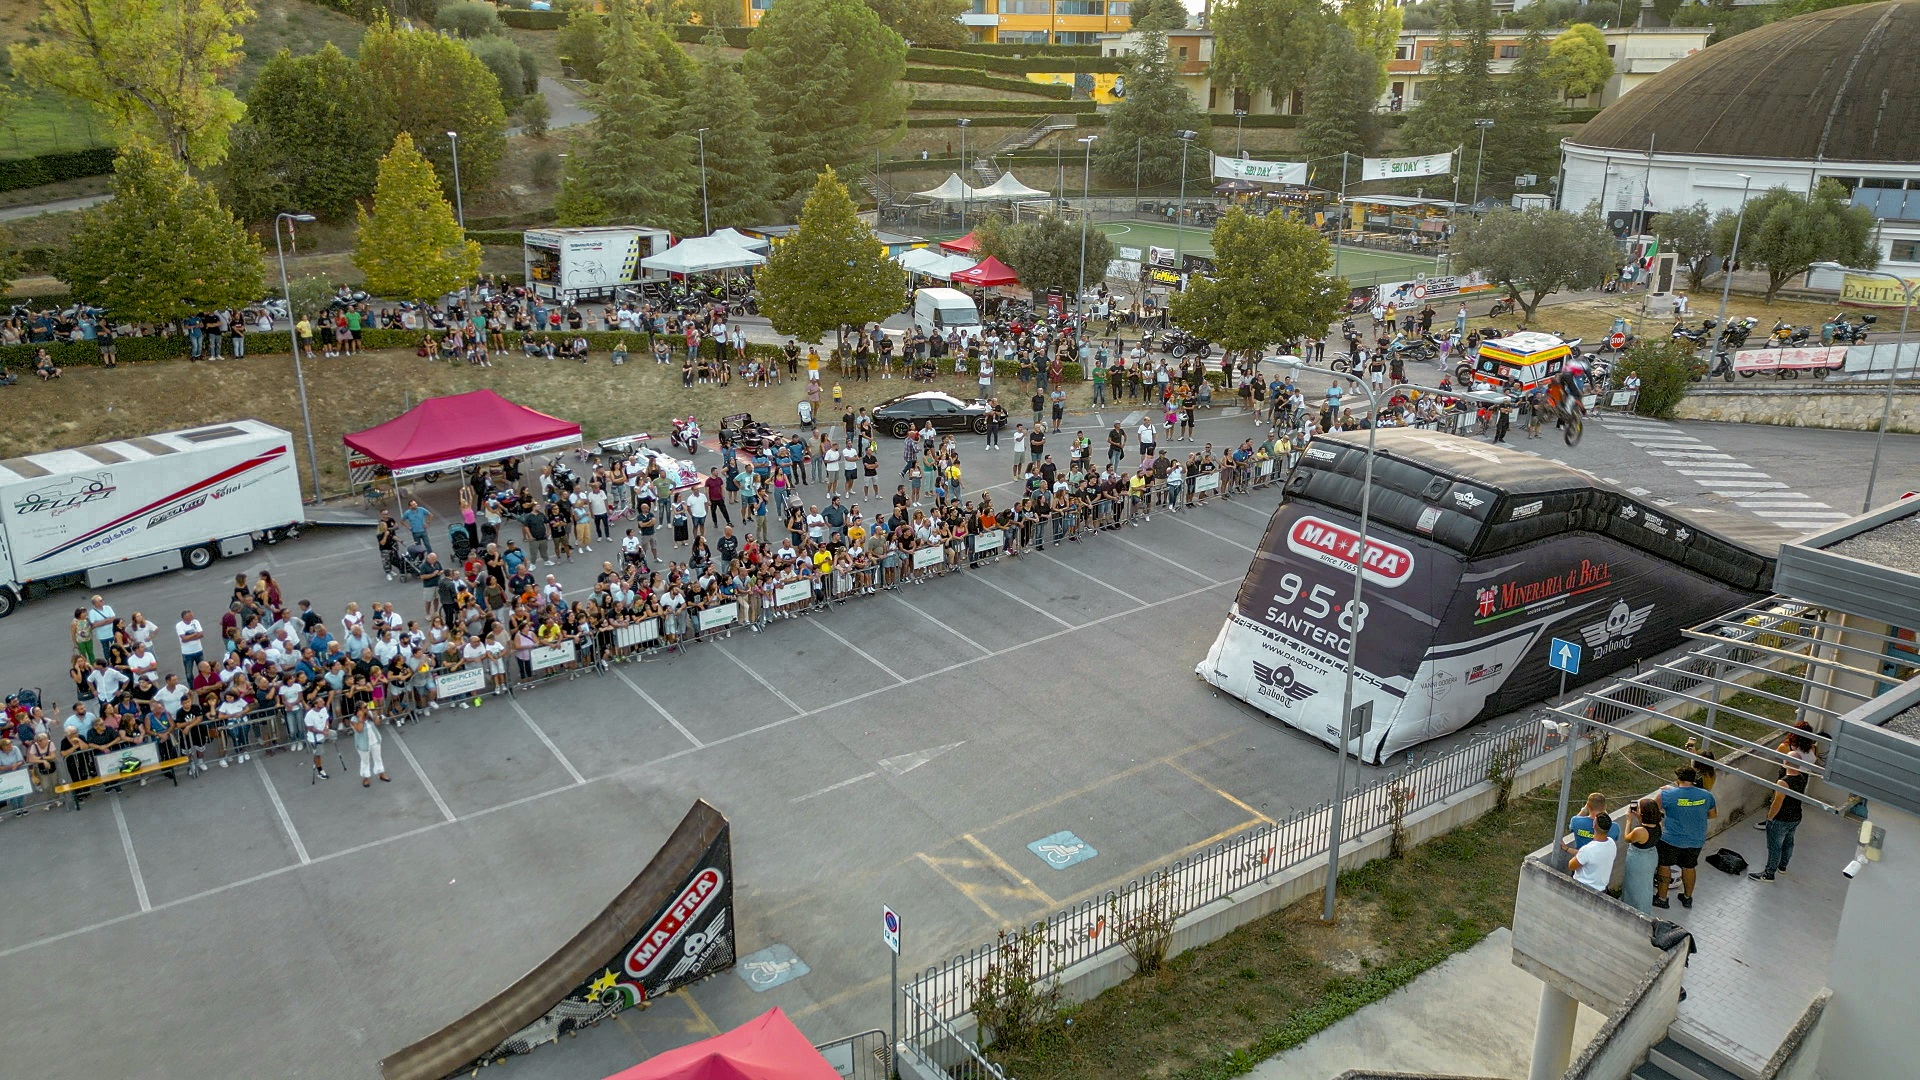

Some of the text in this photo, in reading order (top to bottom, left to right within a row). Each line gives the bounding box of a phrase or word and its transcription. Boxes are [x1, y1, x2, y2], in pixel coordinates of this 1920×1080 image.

[1257, 165, 1273, 177] DAY
[1403, 159, 1419, 172] DAY
[1320, 553, 1358, 572] since 1965
[1565, 568, 1578, 591] di
[1261, 641, 1329, 677] WWW.DABOOT.IT
[634, 879, 715, 966] MA FRA
